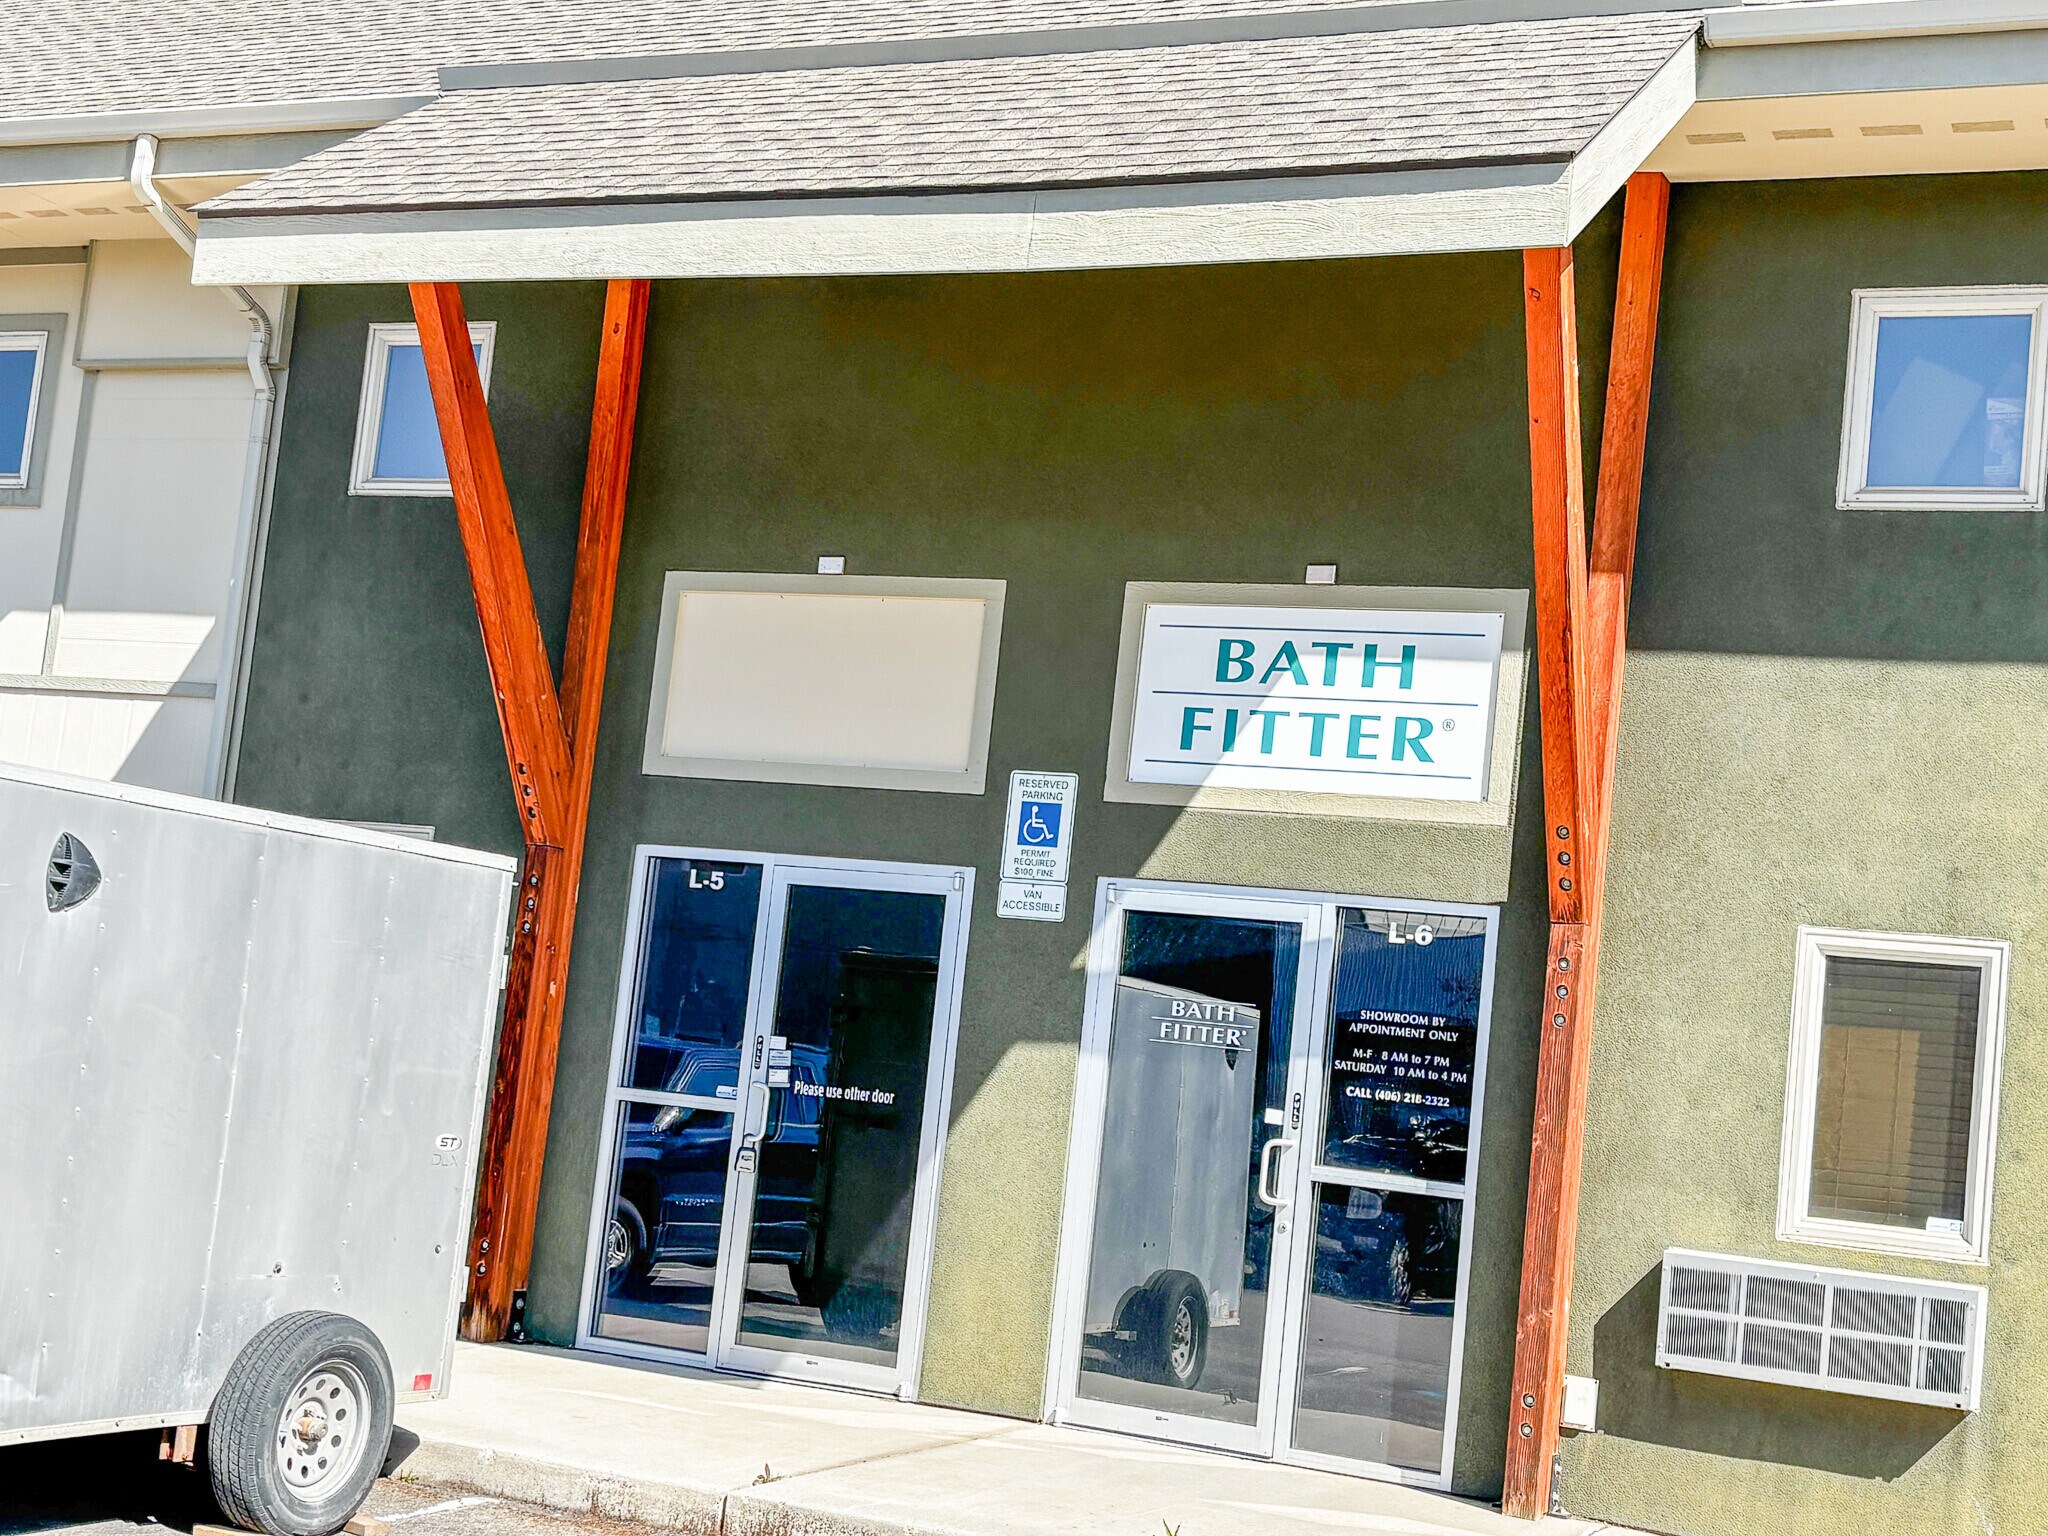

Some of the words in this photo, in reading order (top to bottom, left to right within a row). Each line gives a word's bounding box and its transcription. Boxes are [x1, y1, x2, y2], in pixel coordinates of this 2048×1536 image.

[1214, 638, 1416, 690] BATH
[1018, 778, 1069, 790] RESERVED
[1021, 790, 1064, 801] PARKING
[1020, 849, 1051, 858] PERMIT
[1013, 857, 1056, 868] REQUIRED
[689, 868, 725, 891] L-5
[1014, 867, 1034, 876] $100
[1036, 869, 1054, 878] FINE
[1023, 889, 1043, 900] VAN
[1002, 900, 1061, 913] ACCESSIBLE
[1388, 921, 1434, 946] L-6
[1171, 1000, 1236, 1022] BATH
[1360, 1010, 1428, 1025] SHOWROOM
[1432, 1016, 1446, 1026] BY
[1349, 1023, 1425, 1039] APPOINTMENT
[1429, 1030, 1459, 1042] ONLY
[1381, 1051, 1389, 1061] 8
[1390, 1051, 1409, 1063] AM
[1411, 1053, 1422, 1065] to
[1424, 1055, 1432, 1066] 7
[1433, 1055, 1450, 1068] PM
[1334, 1060, 1387, 1074] SATURDAY
[1393, 1066, 1405, 1077] 10
[1407, 1067, 1426, 1079] AM
[1428, 1068, 1439, 1081] to
[1440, 1071, 1449, 1081] 4
[1450, 1071, 1468, 1084] PM
[794, 1080, 825, 1097] Please
[825, 1086, 843, 1099] use
[843, 1086, 871, 1102] other
[871, 1088, 895, 1105] door
[1345, 1085, 1372, 1099] CALL
[1375, 1088, 1401, 1102] (406)
[440, 1137, 458, 1148] ST
